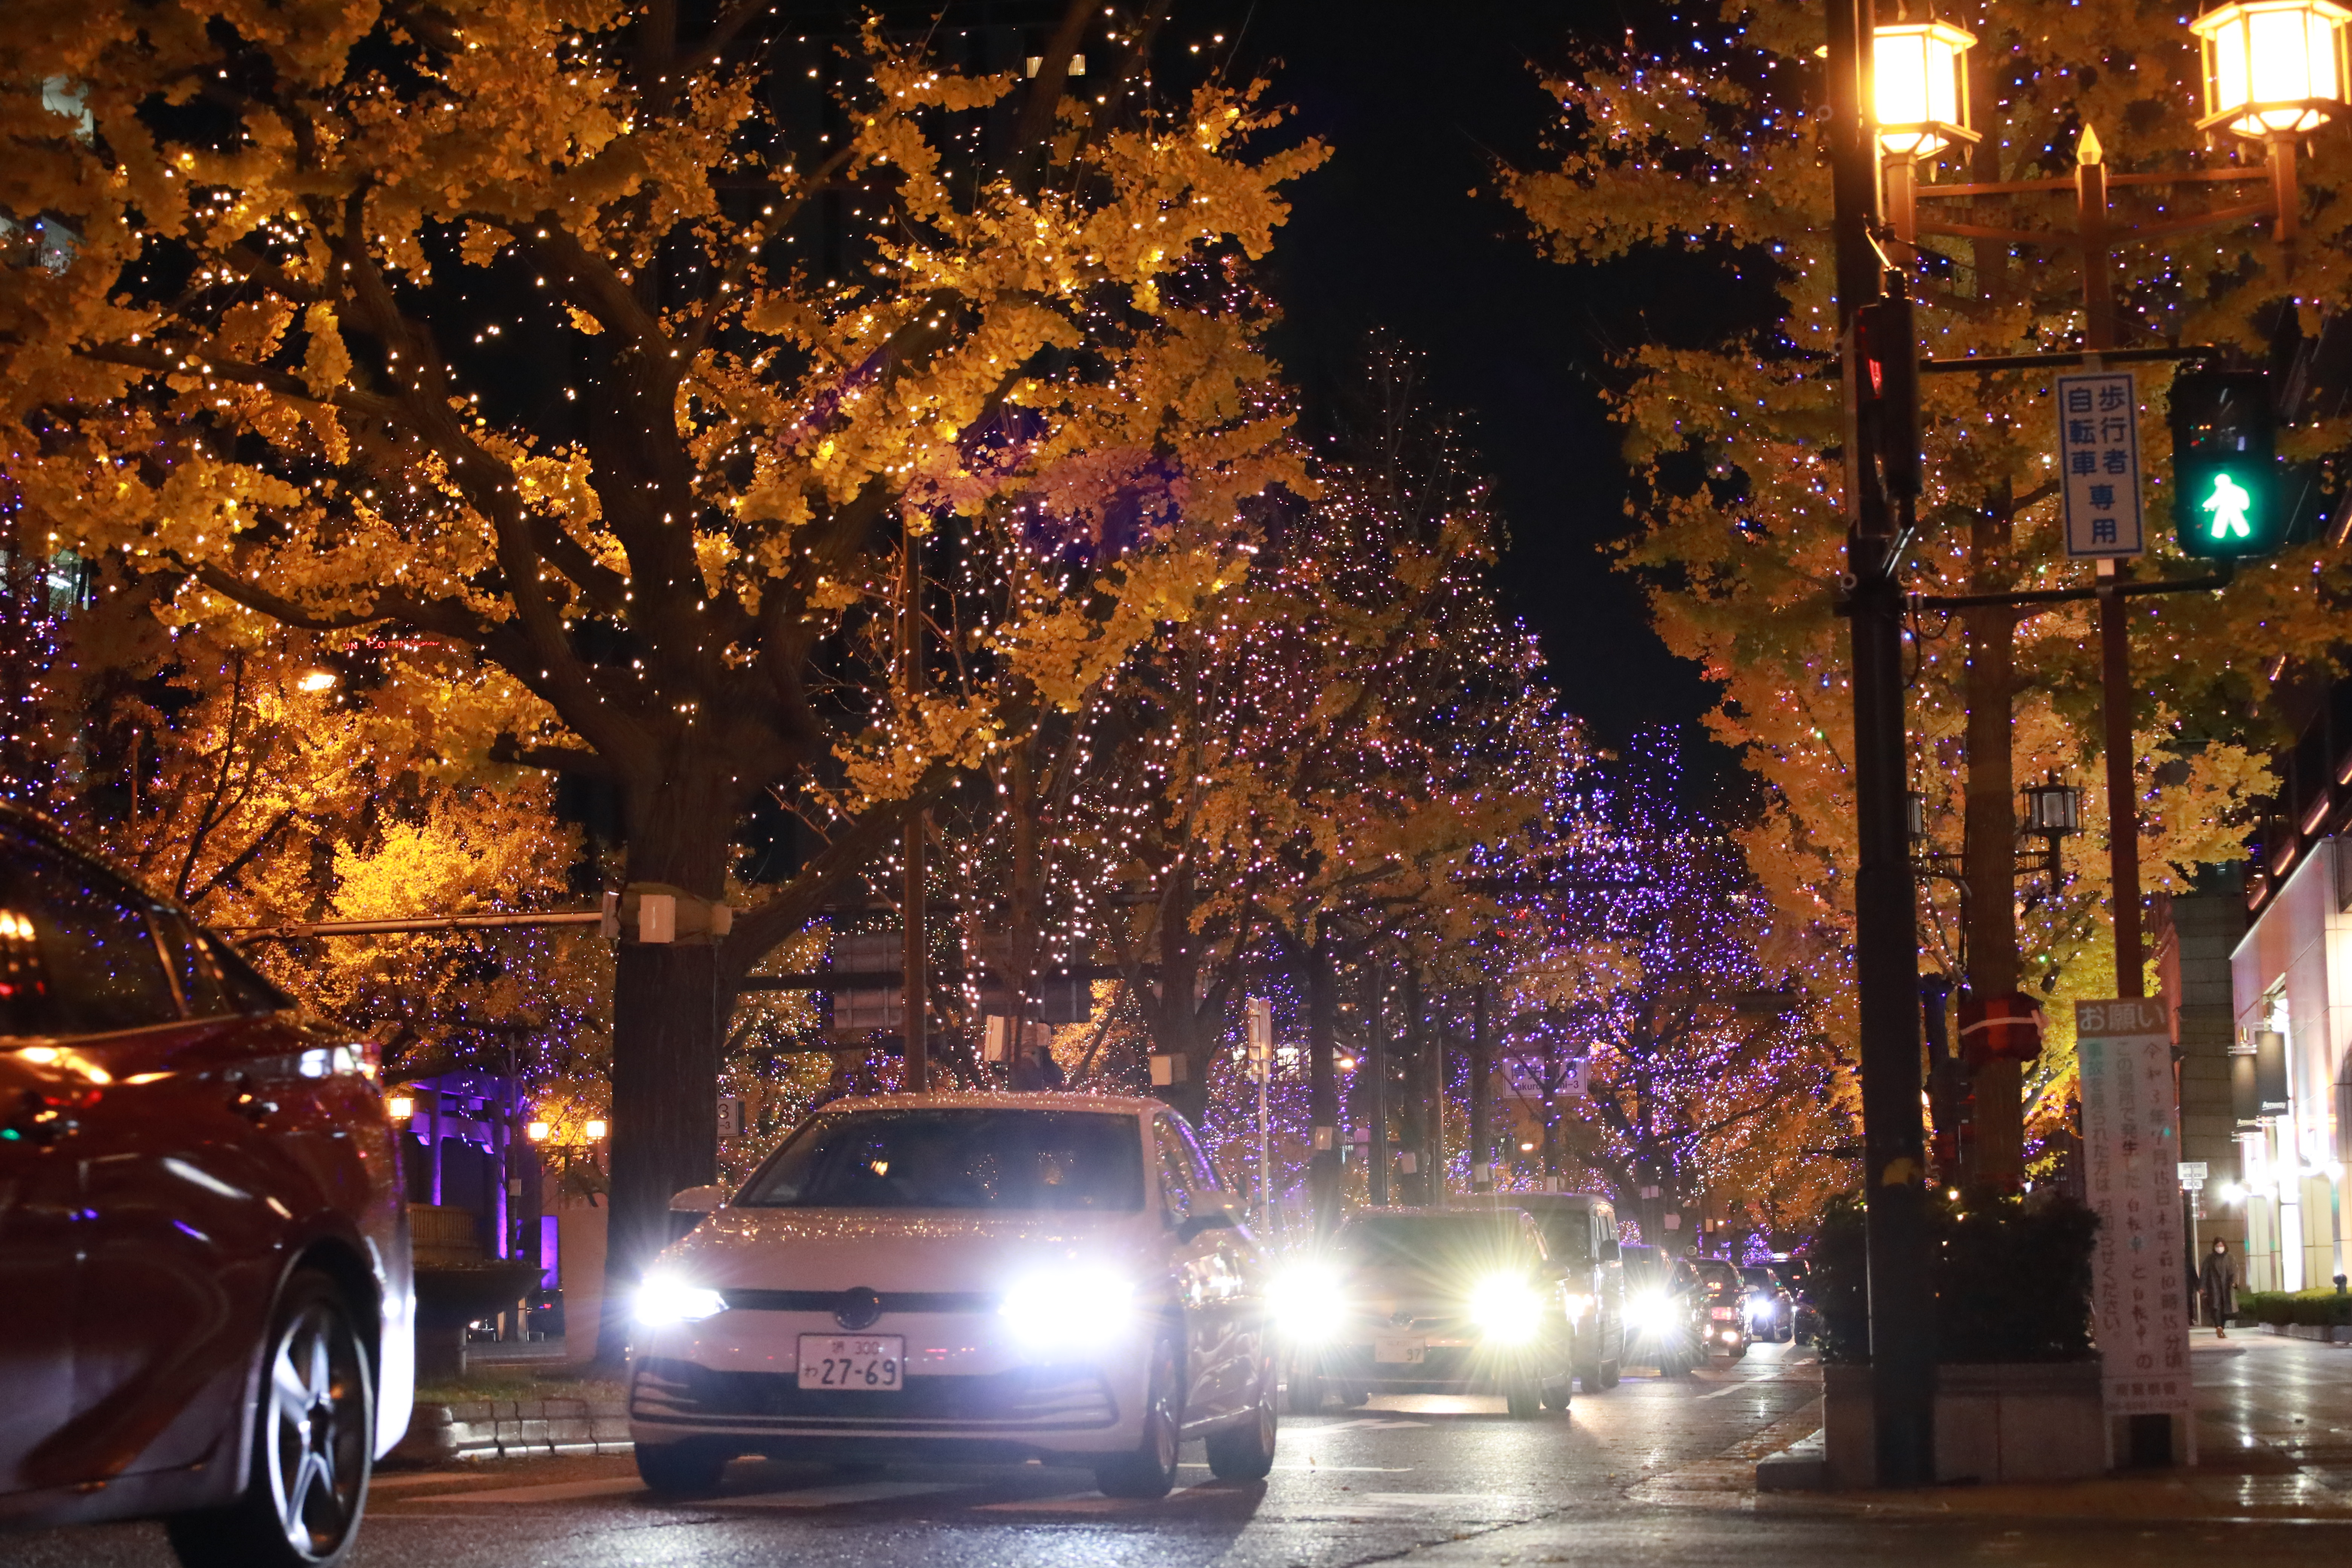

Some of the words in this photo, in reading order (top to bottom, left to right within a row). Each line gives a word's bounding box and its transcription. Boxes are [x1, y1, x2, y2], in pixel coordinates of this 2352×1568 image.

[2069, 387, 2097, 476] 自転車
[2099, 384, 2128, 474] 歩行者
[2089, 484, 2117, 544] 専用
[2079, 1003, 2166, 1031] お願い
[822, 1358, 896, 1385] 27-69
